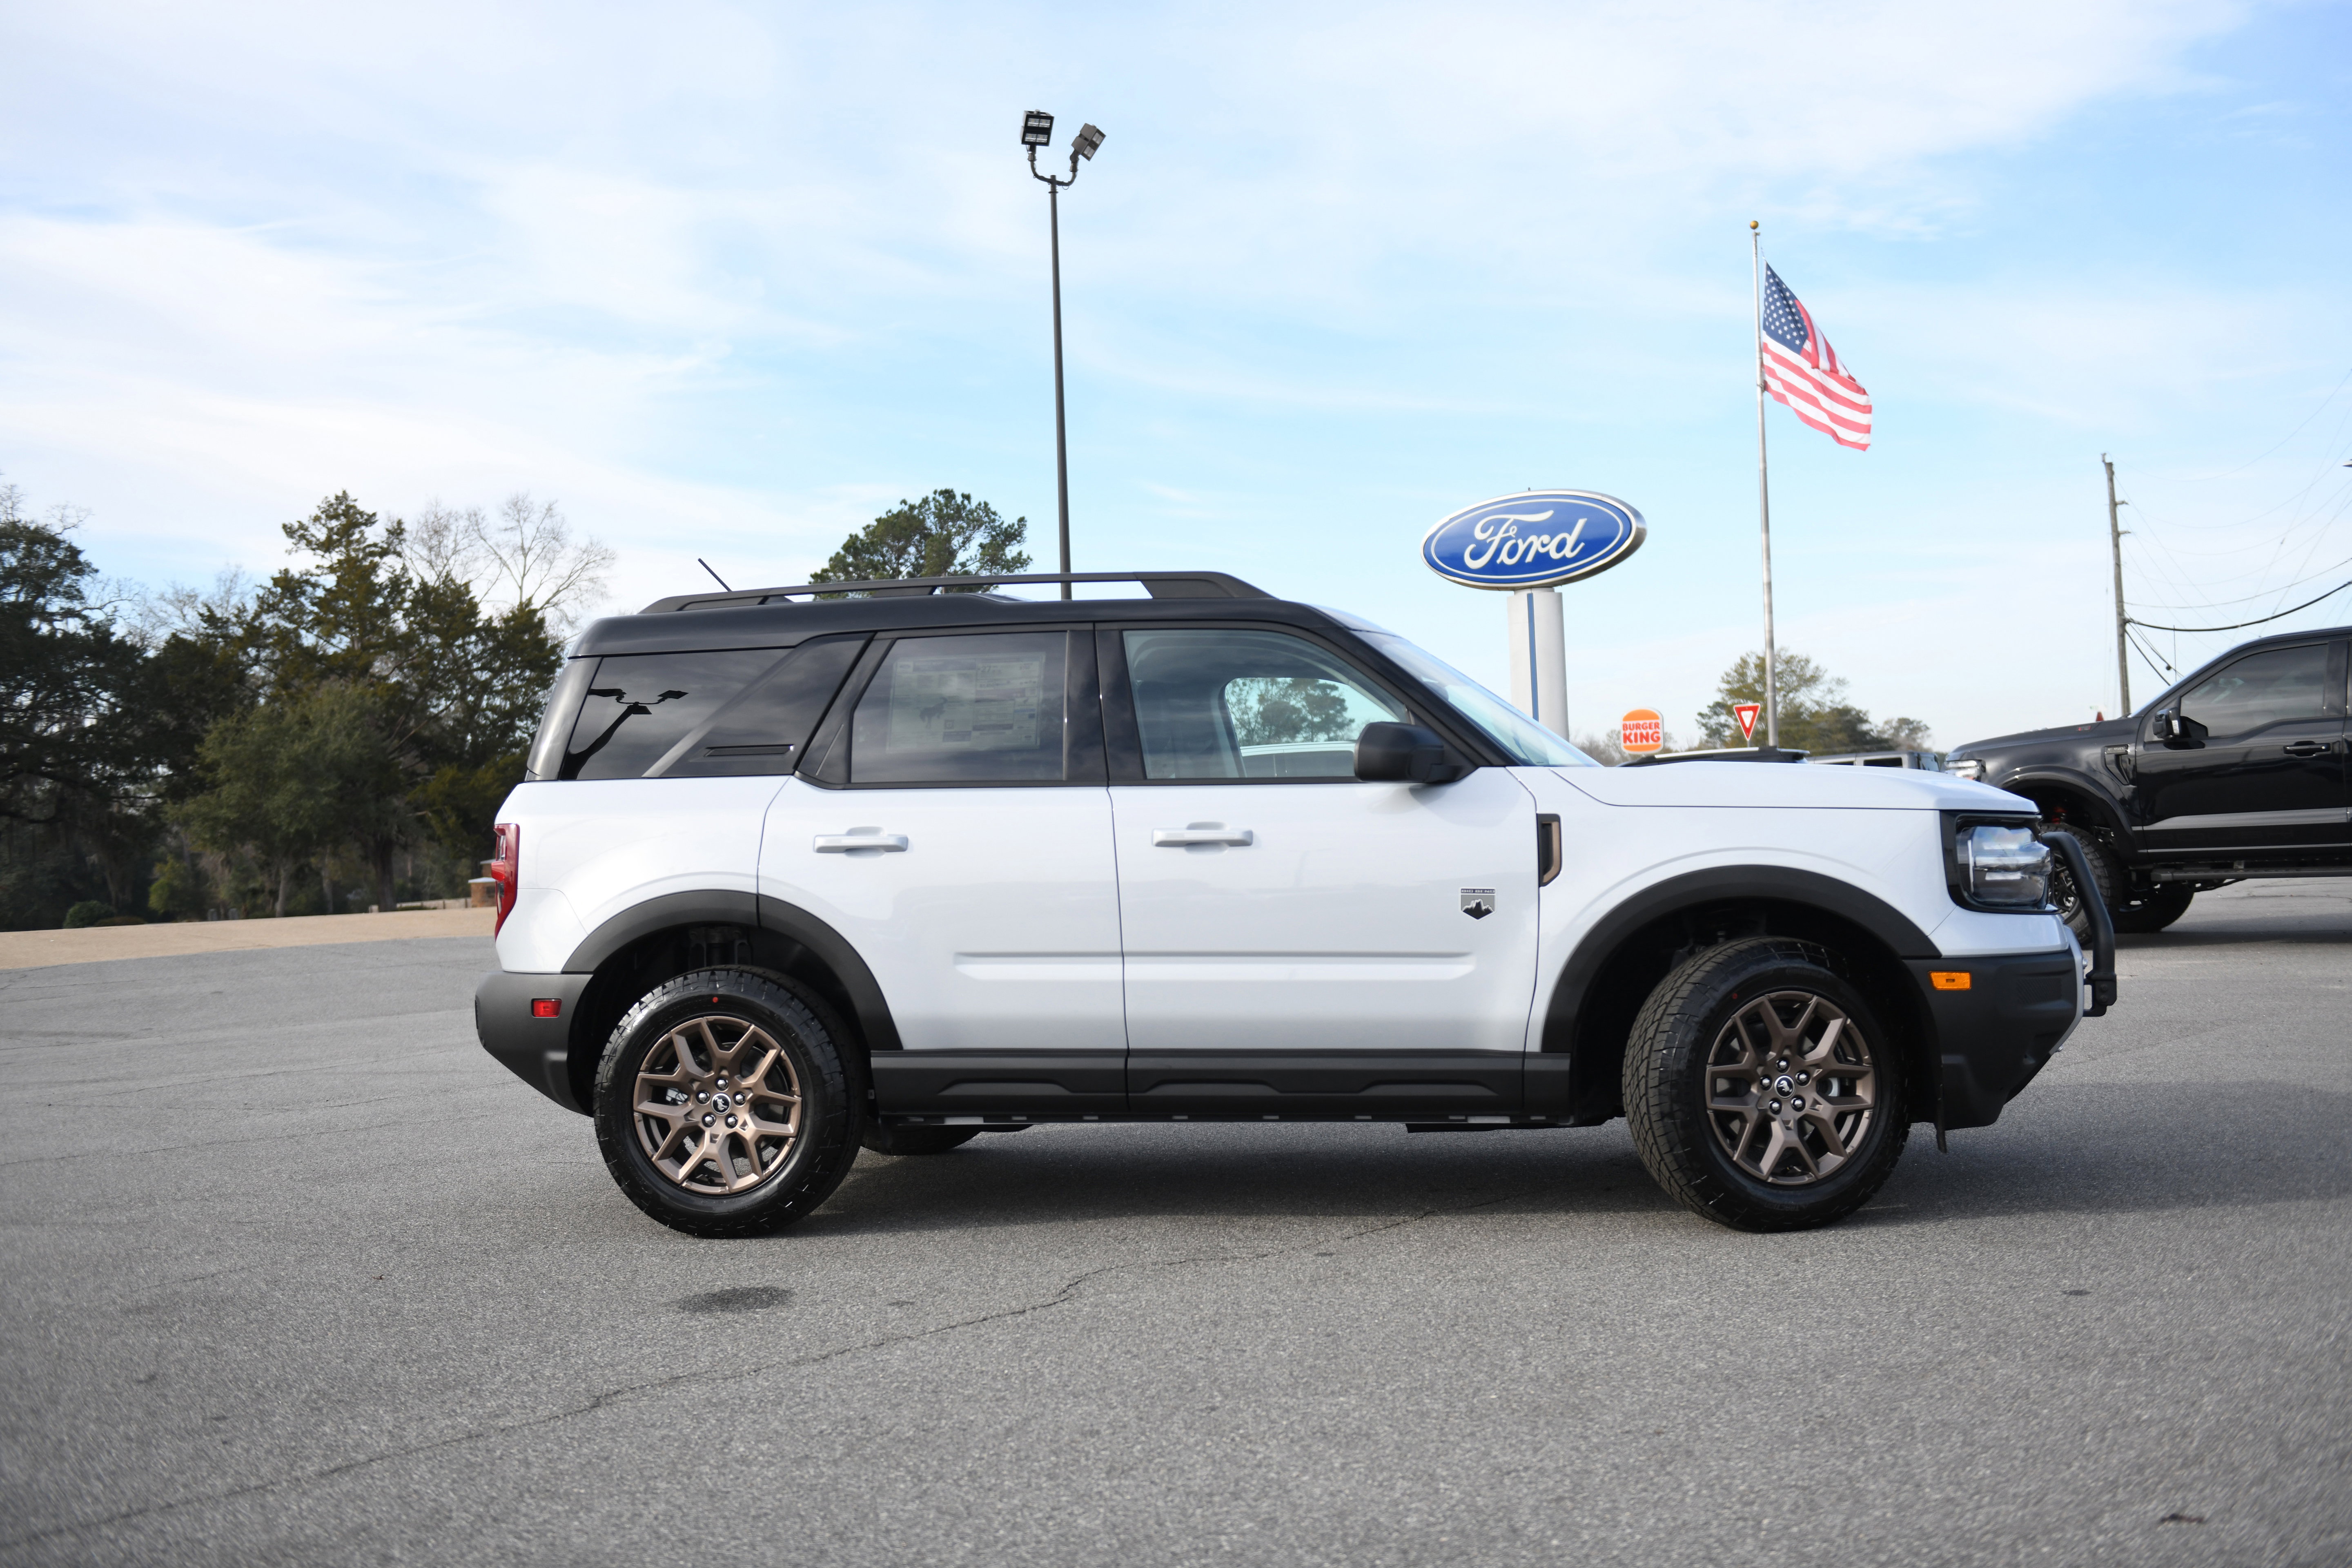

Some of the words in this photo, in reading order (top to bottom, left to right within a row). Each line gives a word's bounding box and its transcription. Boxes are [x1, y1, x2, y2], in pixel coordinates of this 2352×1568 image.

[1464, 510, 1588, 569] Ford
[1622, 722, 1660, 731] BURGER
[1623, 731, 1661, 744] KING
